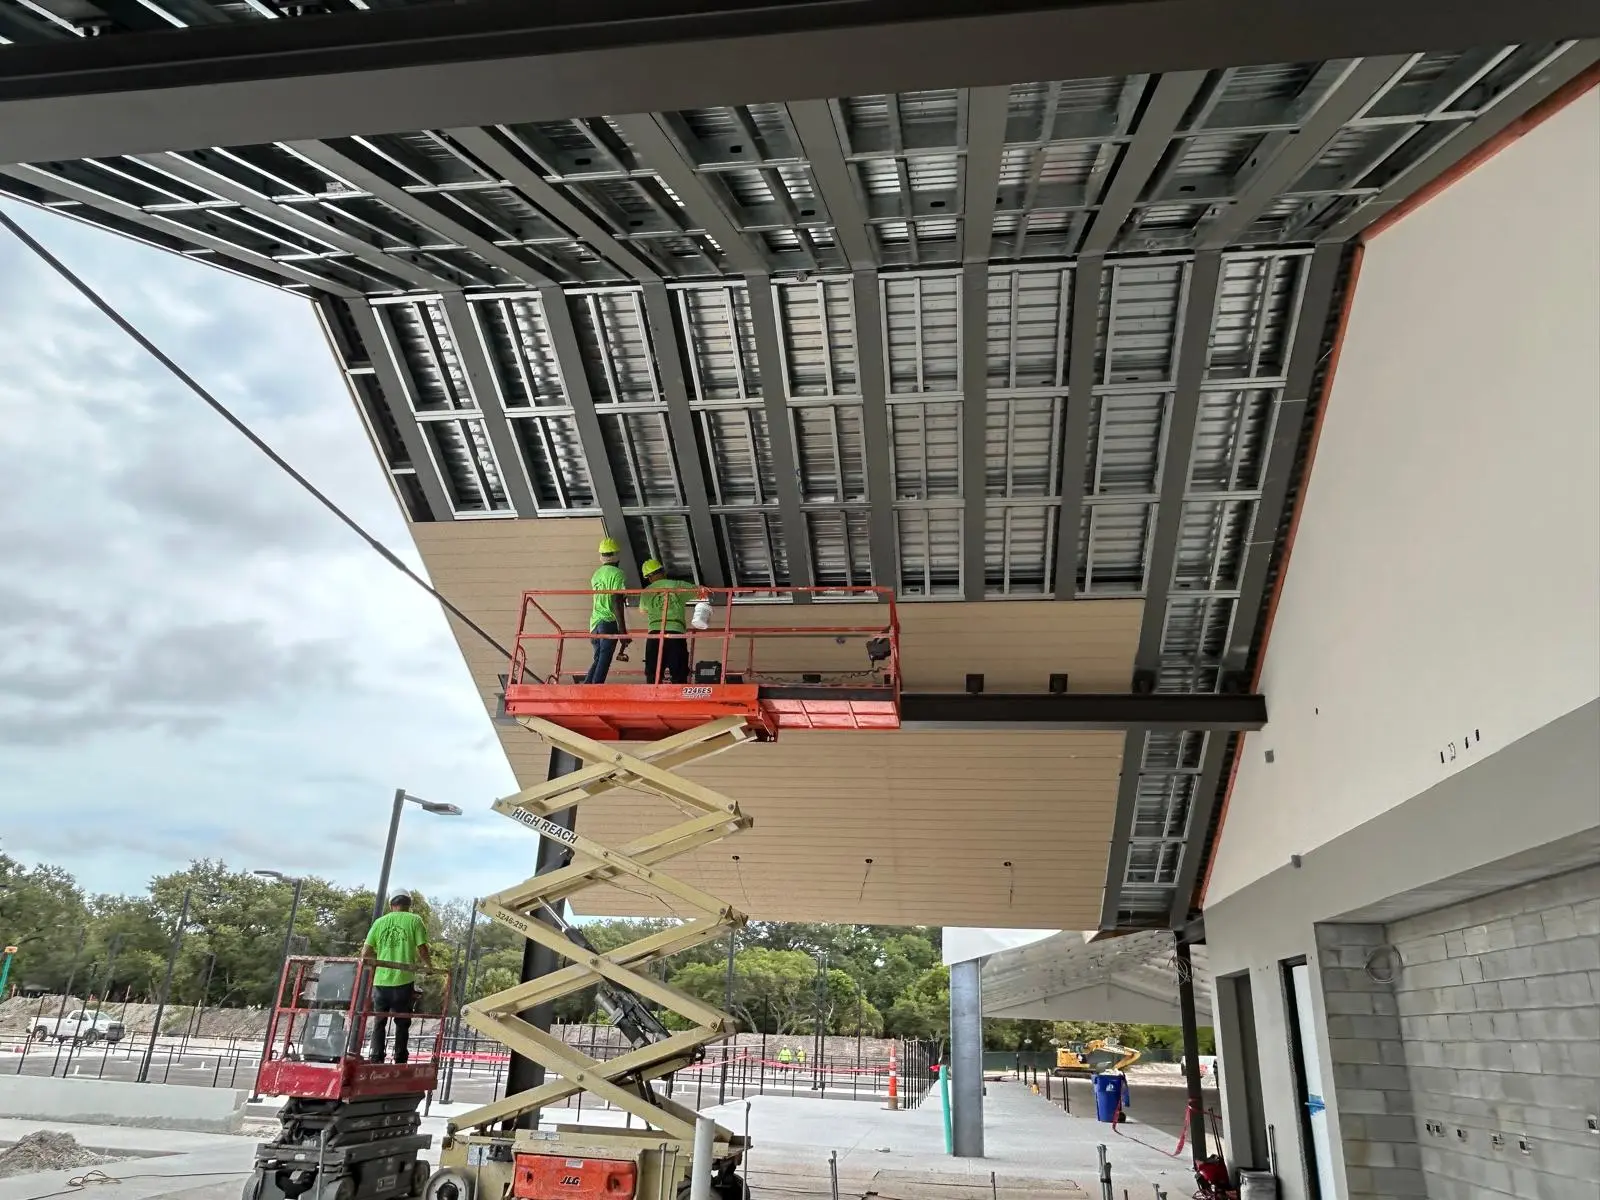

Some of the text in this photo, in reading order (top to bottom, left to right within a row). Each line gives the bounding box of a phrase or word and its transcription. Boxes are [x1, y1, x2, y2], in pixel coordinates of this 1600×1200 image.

[511, 808, 579, 844] HIGH REACH
[495, 911, 528, 931] 3246-293
[560, 1176, 580, 1186] JLG
